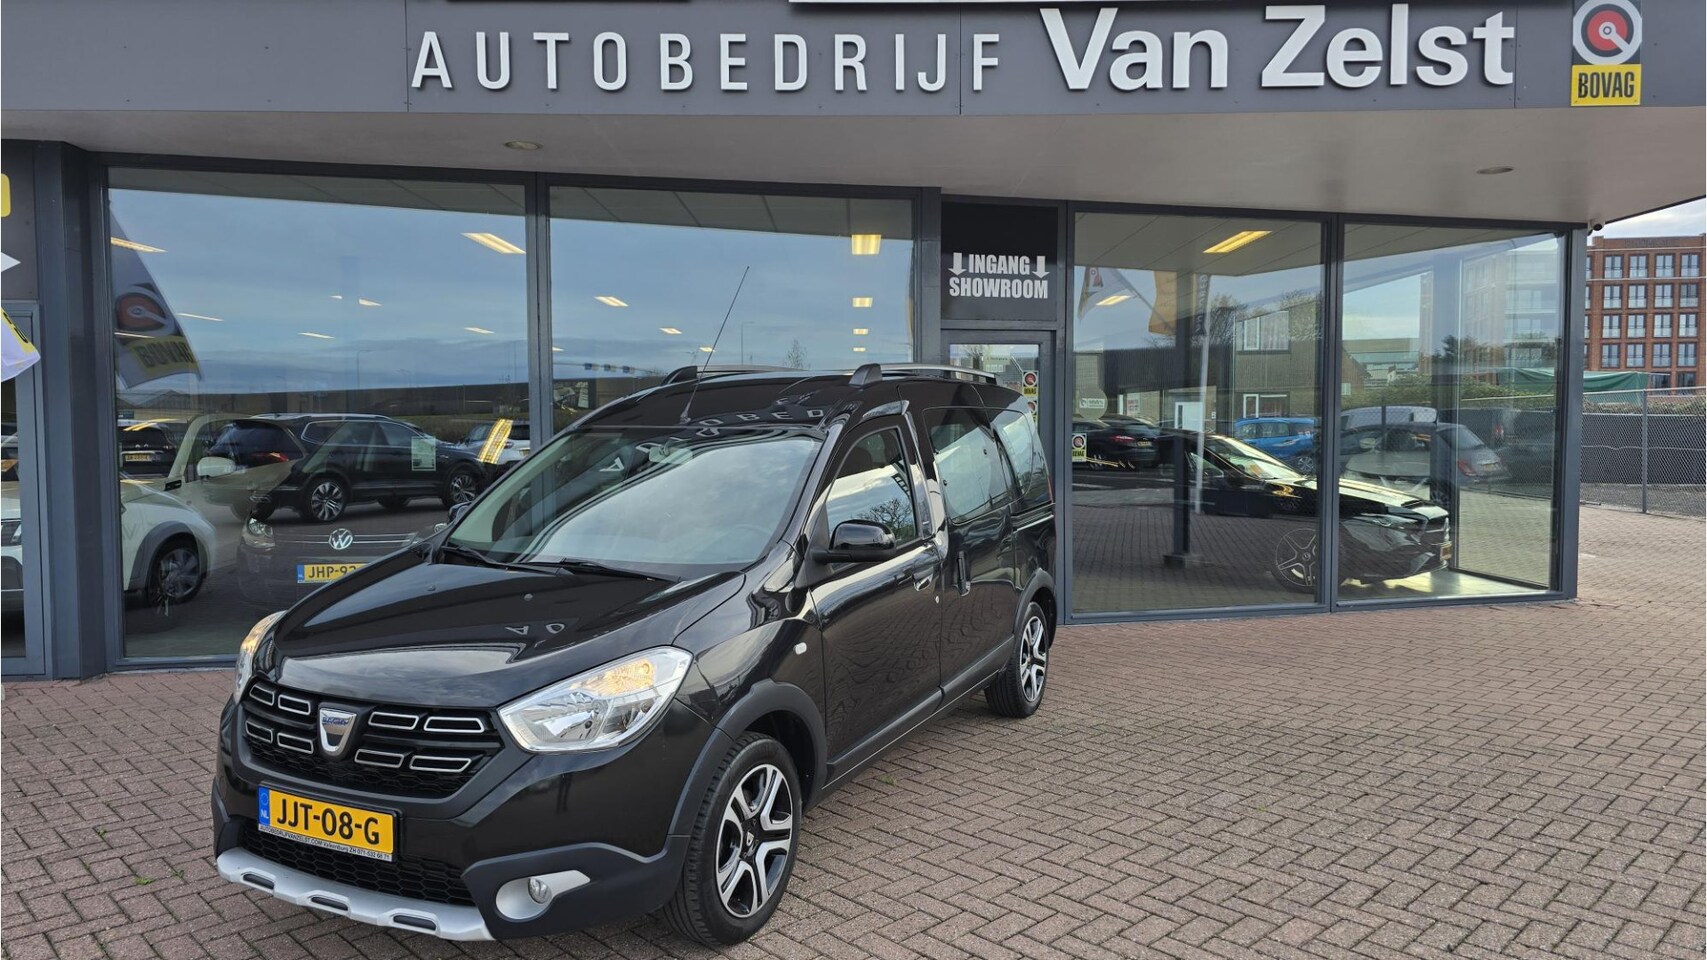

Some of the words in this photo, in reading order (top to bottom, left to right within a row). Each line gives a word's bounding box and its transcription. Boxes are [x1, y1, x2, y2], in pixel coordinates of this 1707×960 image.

[411, 31, 1000, 92] AUTOBEDRIJF
[1039, 7, 1228, 91] Van
[1261, 3, 1515, 88] Zelst
[1577, 71, 1635, 98] BOVAG
[968, 253, 1031, 275] INGANG
[949, 276, 1049, 299] SHOWROOM
[260, 808, 270, 819] NL
[276, 798, 380, 845] JJT-08-G
